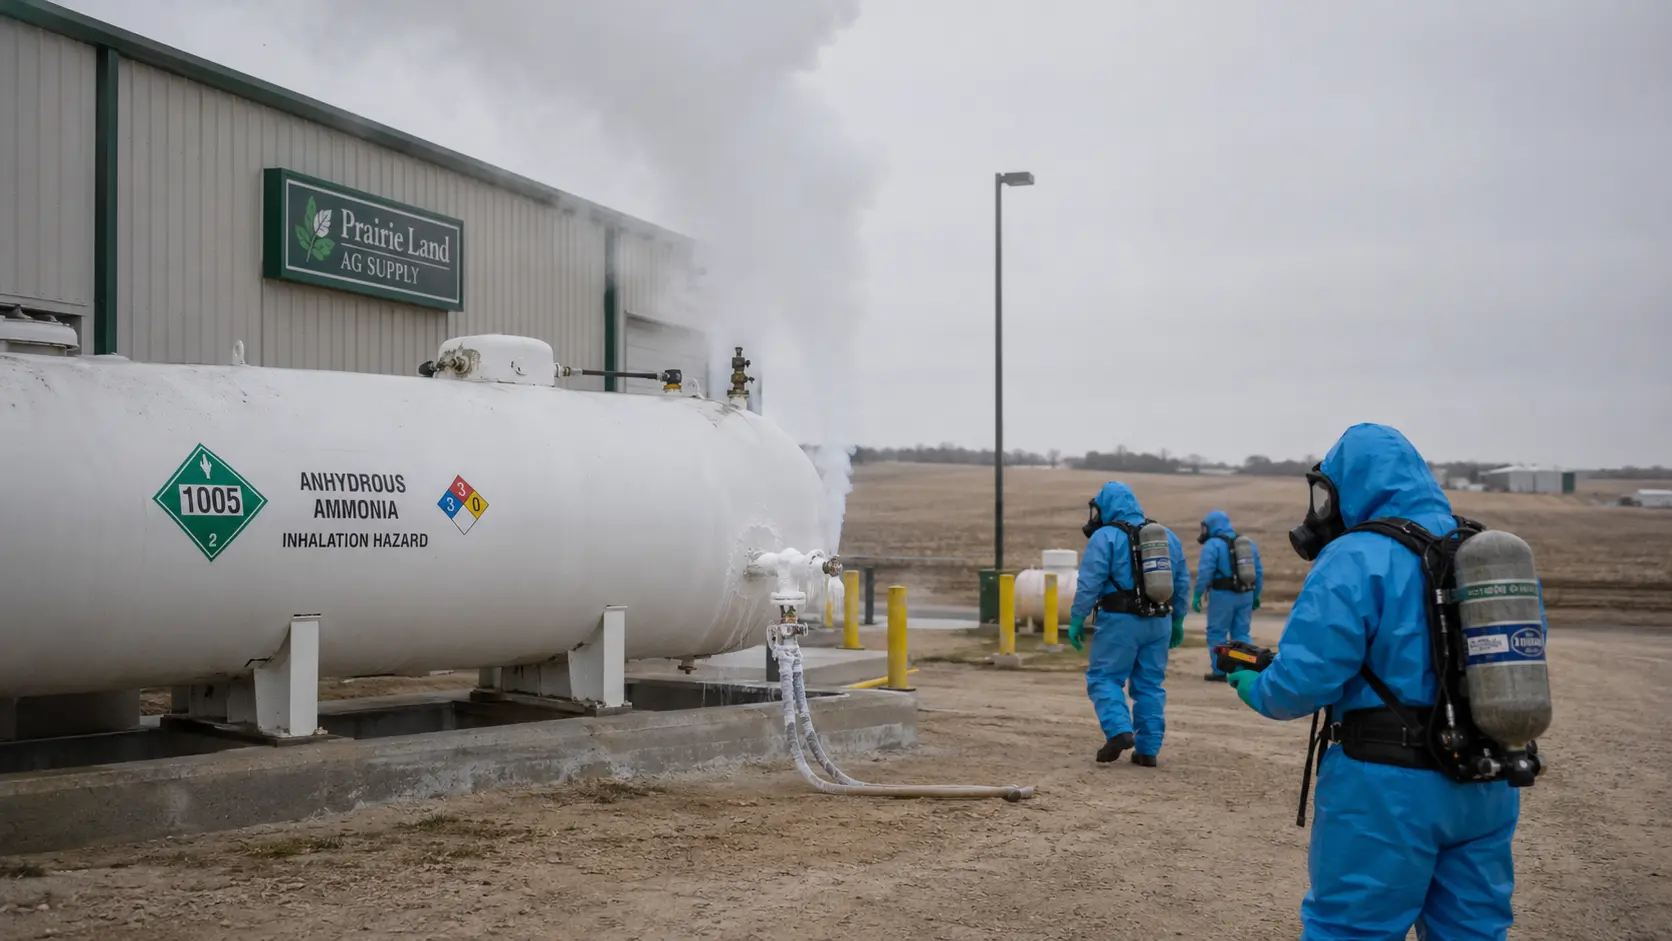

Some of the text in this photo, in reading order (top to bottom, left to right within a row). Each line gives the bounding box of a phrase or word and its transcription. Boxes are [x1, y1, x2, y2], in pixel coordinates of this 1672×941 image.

[340, 208, 450, 263] Prairie Land
[340, 251, 420, 285] AG SUPPLY
[300, 471, 407, 494] ANHYDROUS
[456, 481, 467, 497] 3
[182, 486, 241, 514] 1005
[313, 498, 400, 520] AMMONIA
[446, 497, 456, 512] 3
[472, 497, 481, 513] 0
[208, 532, 218, 548] 2
[282, 532, 429, 549] INHALATION HAZARD
